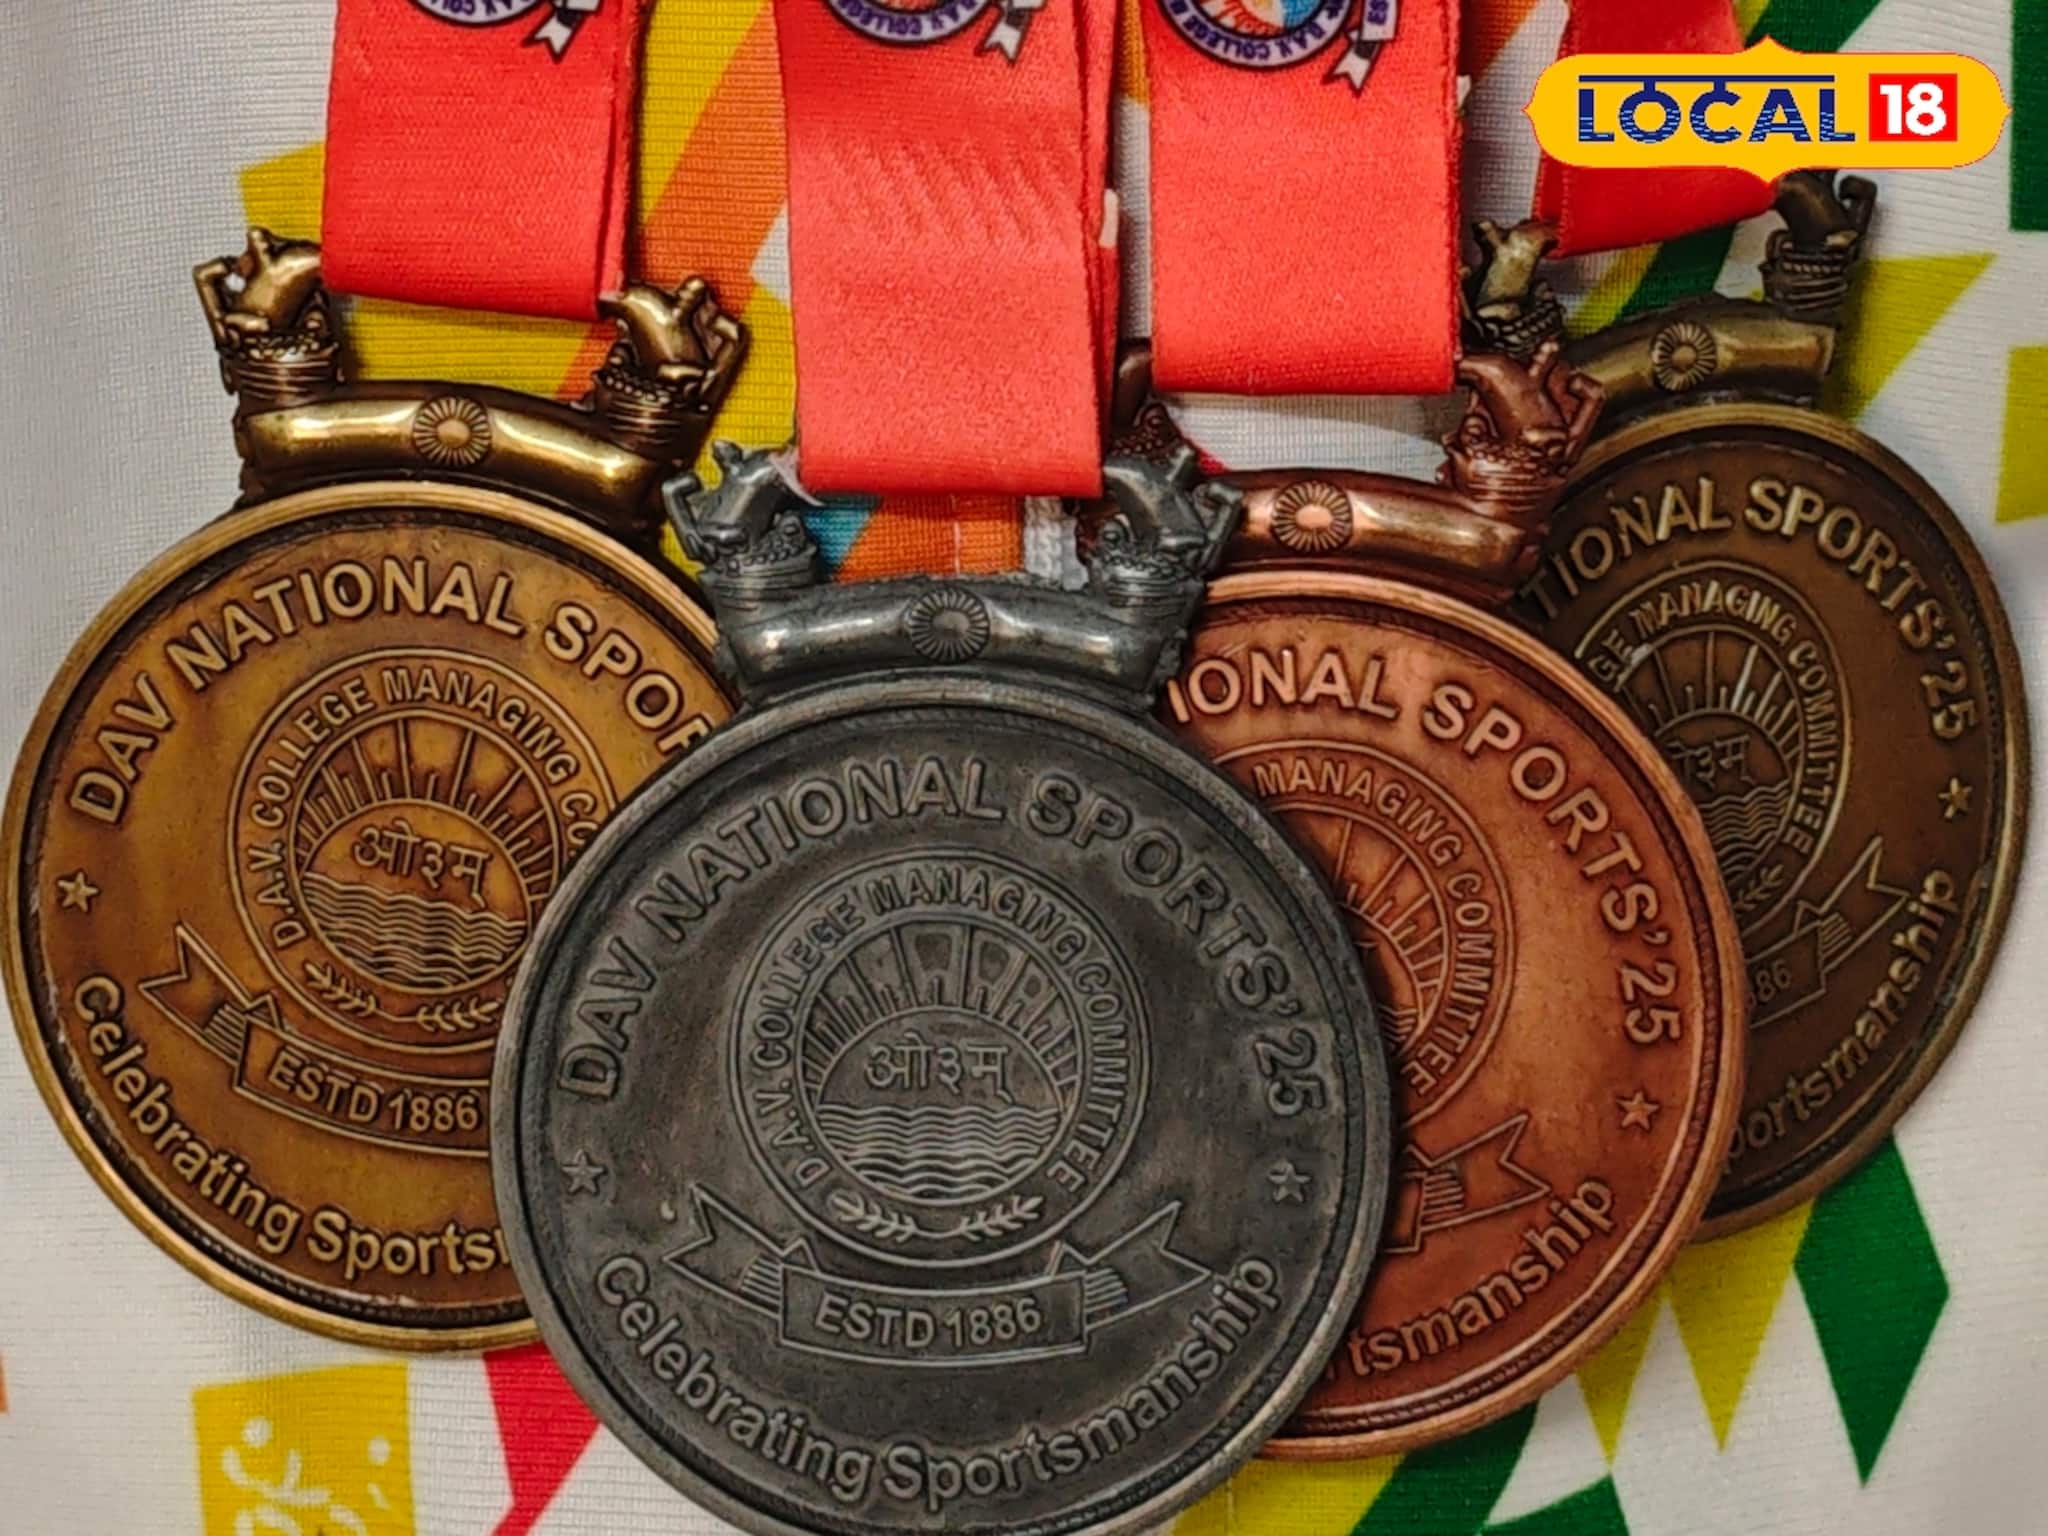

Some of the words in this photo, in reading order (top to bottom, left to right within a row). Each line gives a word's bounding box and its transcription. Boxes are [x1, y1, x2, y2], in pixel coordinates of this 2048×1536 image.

[1183, 15, 1271, 61] COLLEGE
[69, 672, 177, 825] DAV
[165, 557, 527, 692] NATIONAL
[253, 678, 376, 831] COLLEGE
[382, 668, 578, 784] MANAGING
[1629, 580, 1798, 647] MANAGING
[1787, 639, 1839, 855] COMMITTEE
[246, 837, 307, 950] D.A.V.
[556, 936, 657, 1101] DAV
[635, 752, 1006, 945] NATIONAL
[867, 866, 1087, 966] MANAGING
[1253, 759, 1464, 868] MANAGING
[1400, 874, 1500, 1097] COMMITTEE
[750, 893, 866, 1068] COLLEGE
[73, 974, 304, 1255] Celebrating
[267, 1048, 380, 1122] ESTD
[388, 1090, 480, 1134] 1886
[753, 1078, 831, 1188] D.A.V.
[1046, 961, 1128, 1193] COMMITTEE
[597, 1252, 872, 1504] Celebrating
[883, 1254, 1282, 1511] Sportsmanship
[812, 1290, 938, 1350] ESTD
[943, 1296, 1043, 1350] 1886
